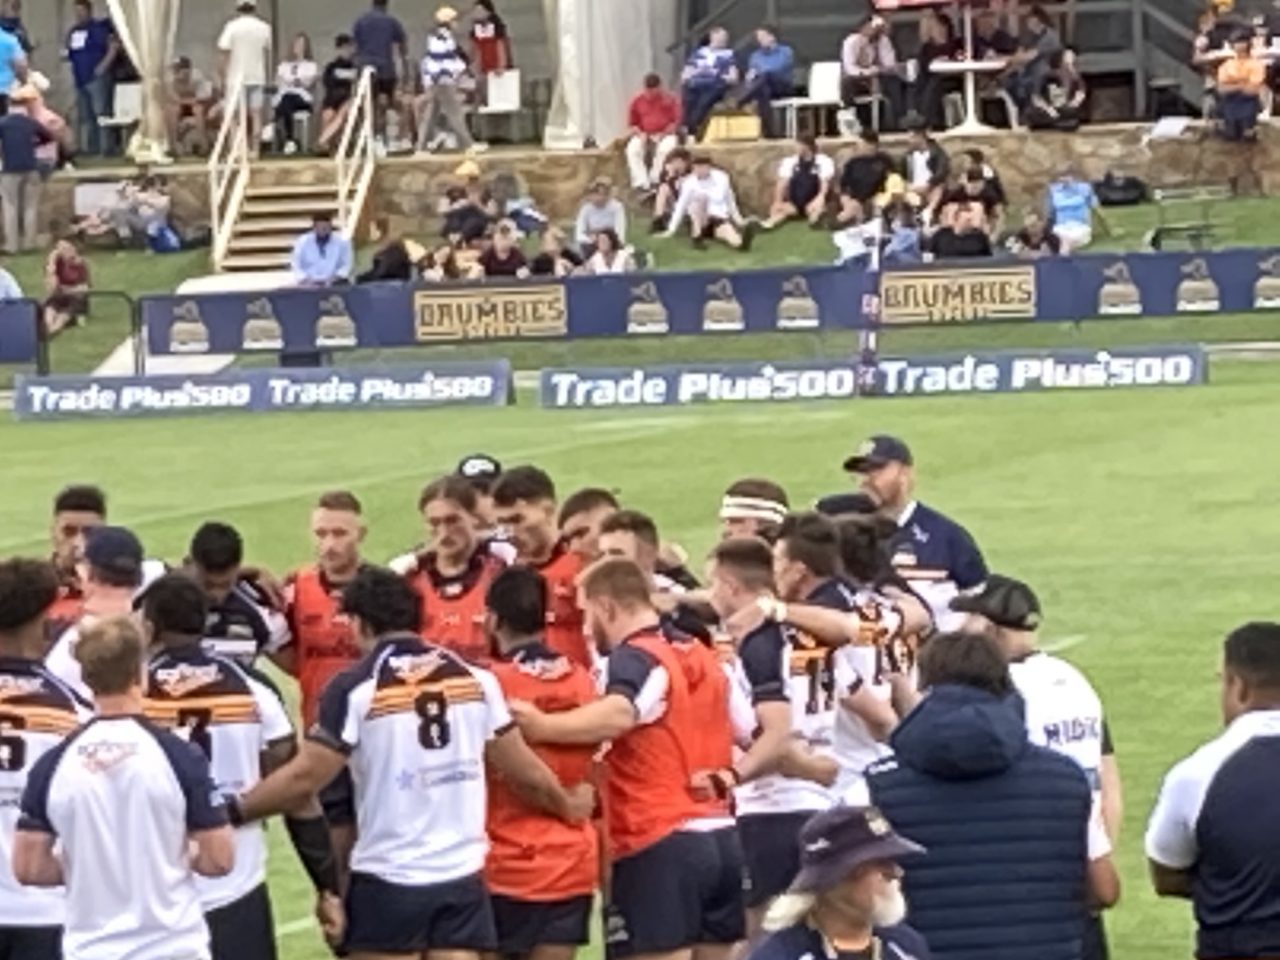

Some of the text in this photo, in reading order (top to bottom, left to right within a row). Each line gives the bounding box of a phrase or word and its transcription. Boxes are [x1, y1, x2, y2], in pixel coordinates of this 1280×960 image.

[268, 376, 356, 405] Trade
[550, 369, 667, 407] Trade
[878, 355, 1000, 393] Trade
[27, 384, 117, 412] Trade
[414, 691, 451, 750] 8
